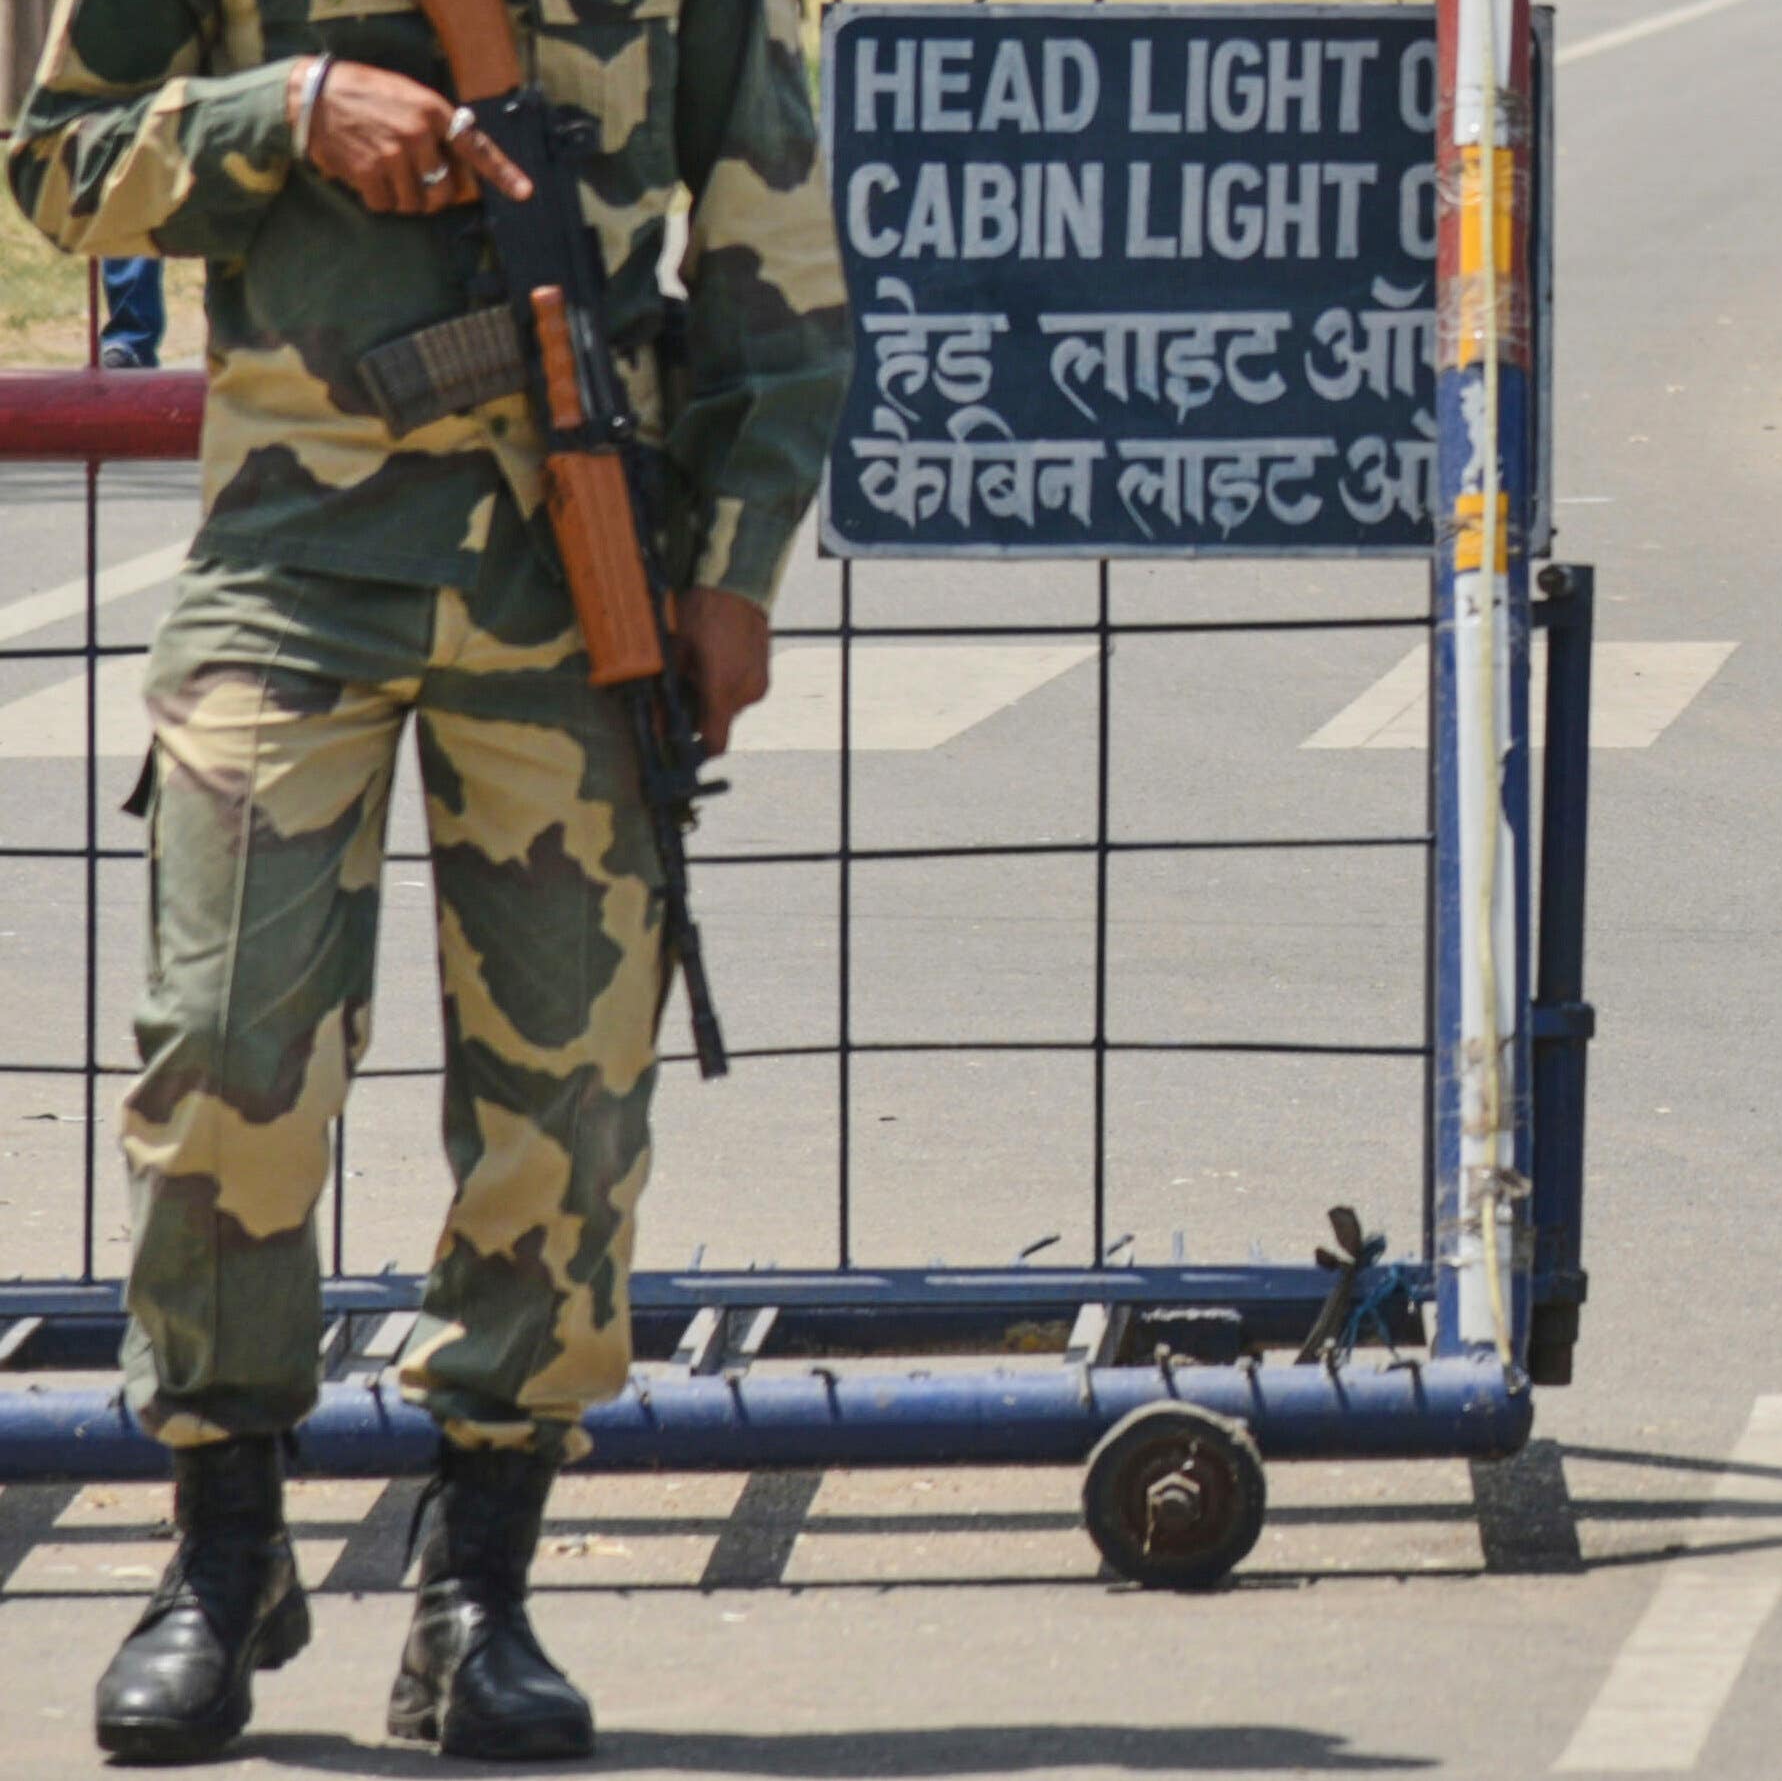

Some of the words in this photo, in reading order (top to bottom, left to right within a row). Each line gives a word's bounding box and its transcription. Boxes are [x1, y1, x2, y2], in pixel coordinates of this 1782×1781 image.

[855, 39, 1100, 133] HEAD
[1129, 39, 1378, 132] LIGHT
[847, 162, 1103, 259] CABIN
[1126, 162, 1377, 259] LIGHT
[862, 276, 1010, 421] हेड
[1036, 310, 1294, 425] लाइट
[1115, 436, 1340, 538] लाइट
